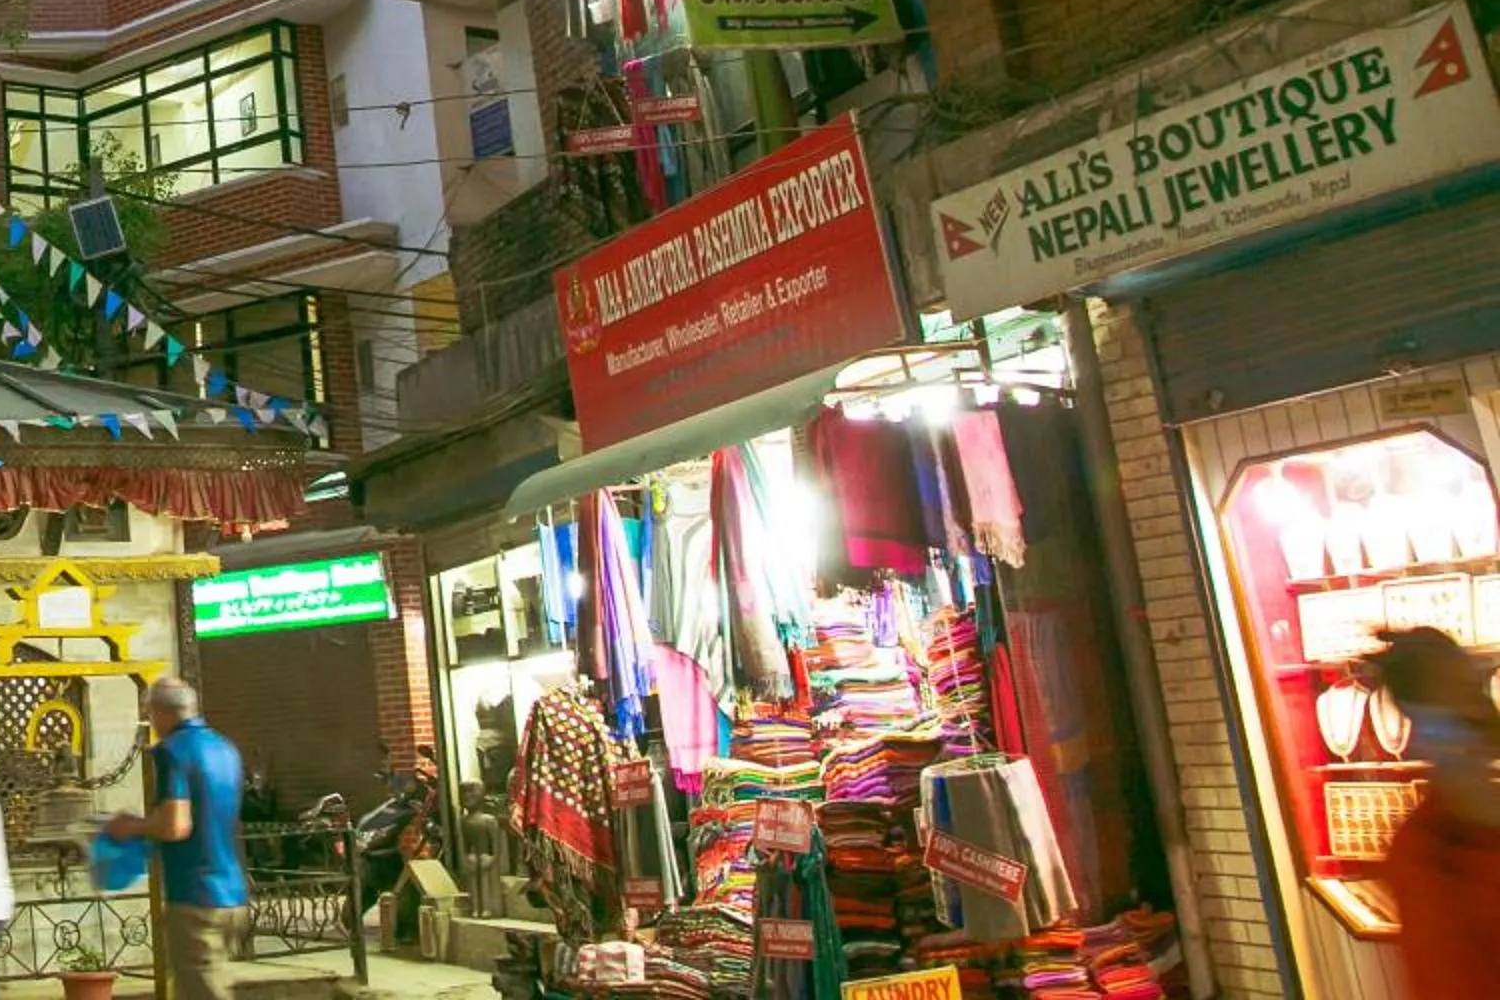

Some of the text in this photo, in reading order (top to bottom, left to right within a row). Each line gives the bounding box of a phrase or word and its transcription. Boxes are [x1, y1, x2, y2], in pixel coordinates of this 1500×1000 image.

[1016, 150, 1113, 219] ALI'S
[1126, 46, 1392, 178] BOUTIQUE
[1027, 97, 1397, 264] NEPALI JEWELLERY
[693, 195, 773, 280] PASHMINA
[767, 149, 865, 245] EXPORTER
[720, 289, 764, 328] Retailer
[763, 282, 776, 309] &
[775, 265, 828, 306] Exporter
